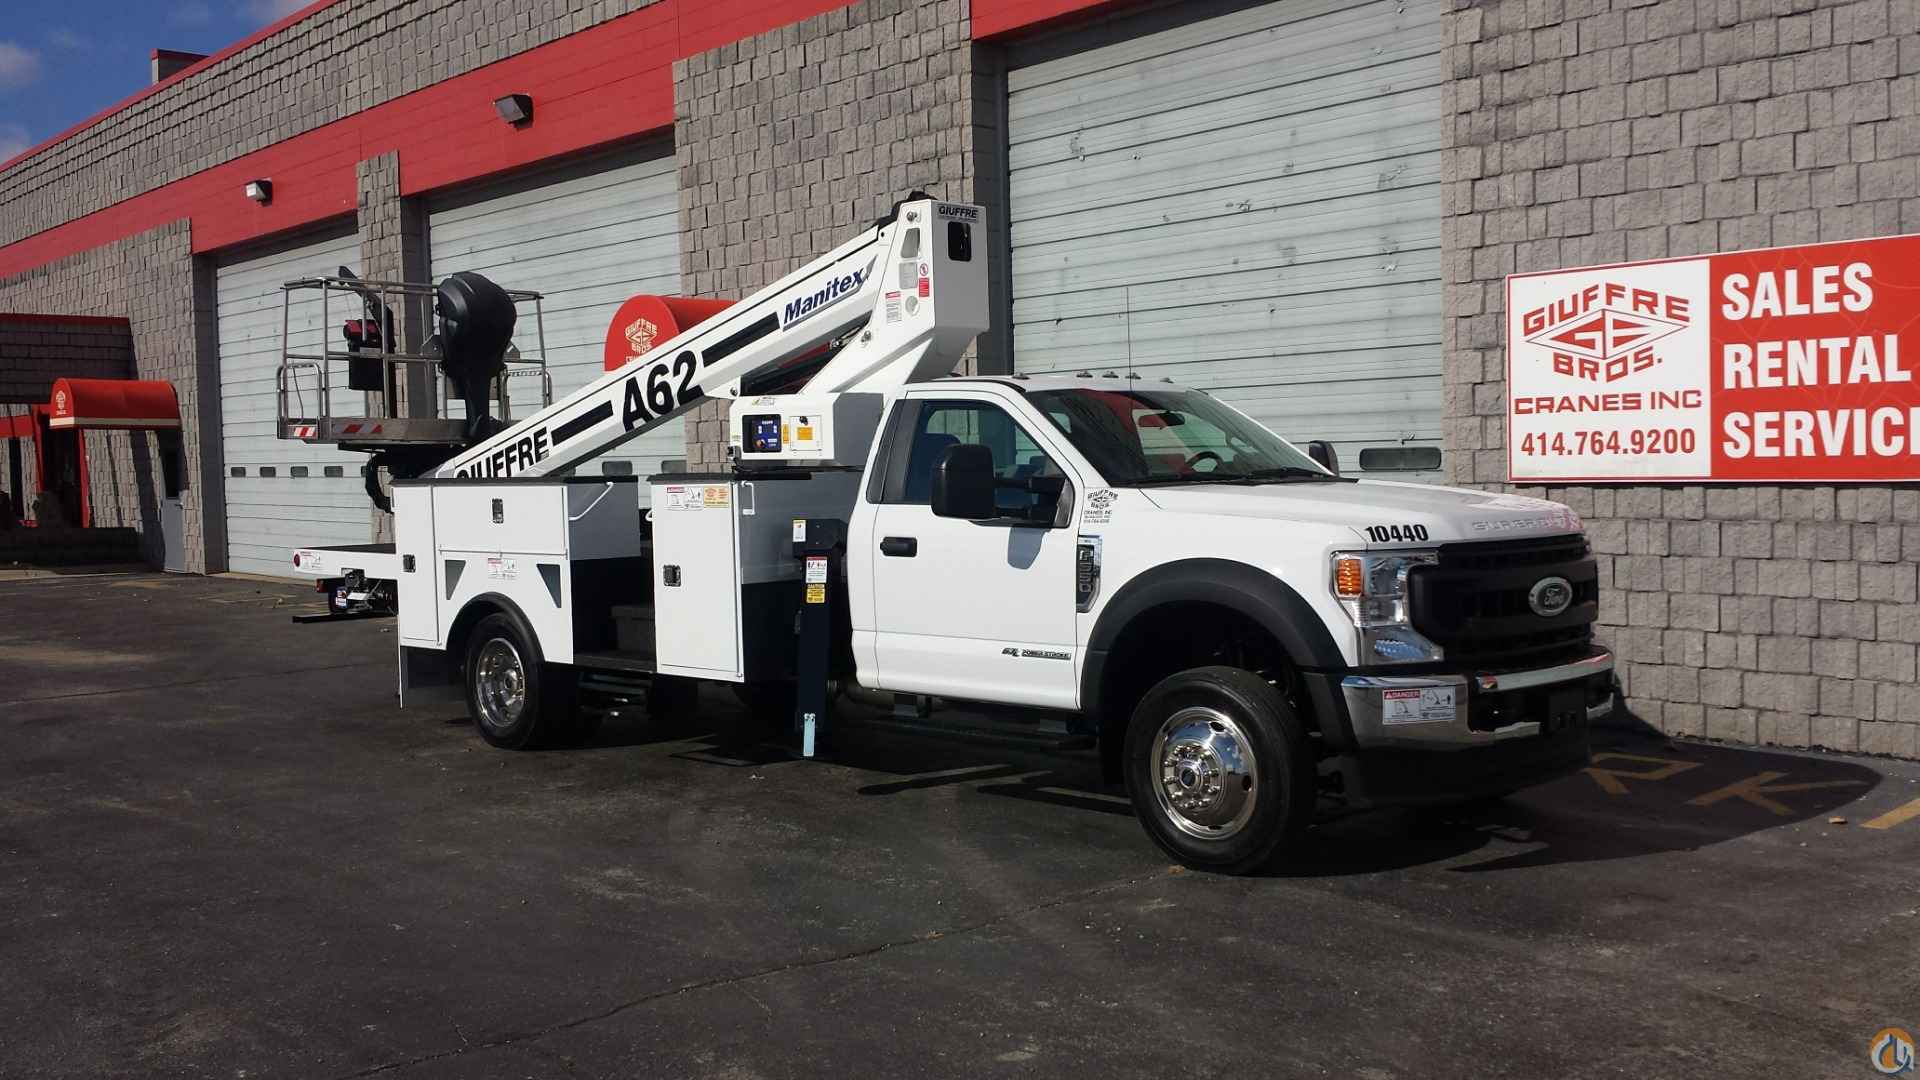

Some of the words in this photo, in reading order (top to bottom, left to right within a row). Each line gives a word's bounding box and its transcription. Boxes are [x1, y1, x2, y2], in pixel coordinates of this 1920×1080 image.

[938, 205, 979, 219] GIUFFRE
[783, 264, 866, 324] Manitex
[1523, 282, 1690, 337] GIUFFRE
[1722, 262, 1873, 321] SALES
[1553, 346, 1663, 383] BROS.
[1723, 334, 1912, 390] RENTAL
[622, 349, 705, 433] A62
[1514, 392, 1642, 415] CRANES
[1650, 389, 1702, 410] INC
[1521, 428, 1696, 456] 414.764.9200
[1365, 524, 1429, 543] 10440
